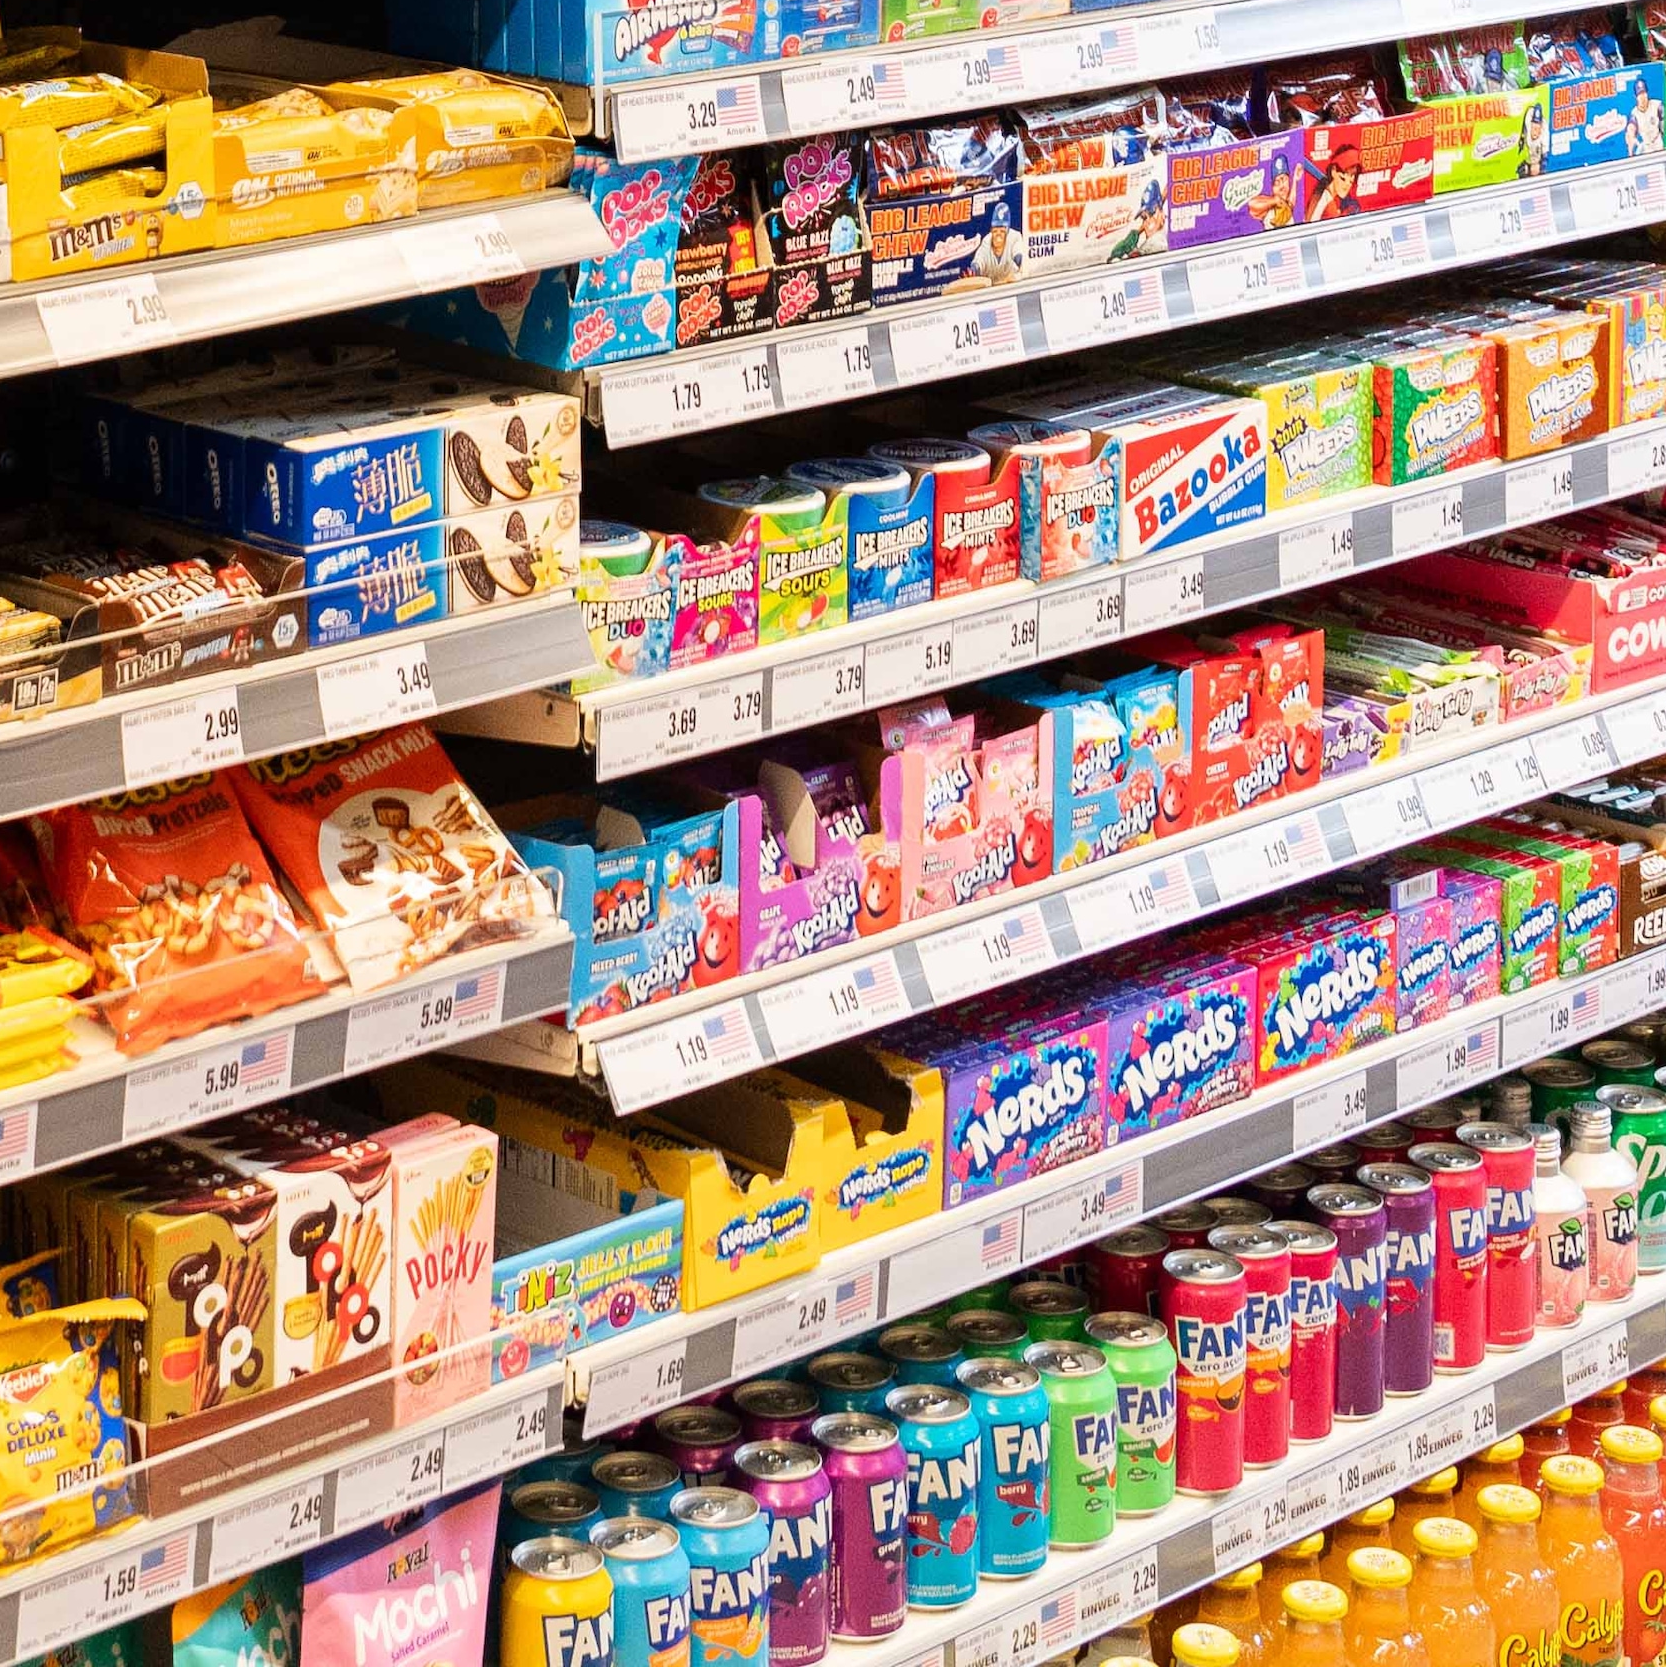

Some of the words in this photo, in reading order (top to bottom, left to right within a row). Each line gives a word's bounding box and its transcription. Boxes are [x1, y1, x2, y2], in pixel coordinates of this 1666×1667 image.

[1172, 155, 1201, 180] BIG
[1205, 149, 1258, 174] LEAGUE
[1027, 181, 1056, 203] BIG
[1061, 174, 1127, 201] LEAGUE
[1172, 176, 1220, 199] CHEW
[871, 203, 904, 228] BIG
[909, 198, 972, 224] LEAGUE
[1028, 204, 1081, 228] CHEW
[872, 231, 929, 257] CHEW
[1028, 232, 1069, 246] BUBBLE
[1028, 244, 1054, 258] GUM
[575, 309, 603, 336] POP
[573, 325, 616, 362] ROCKS
[1274, 419, 1304, 448] SOUR
[1129, 444, 1184, 490] ORIGINAL
[1135, 425, 1261, 543] Bazooka
[1209, 470, 1244, 511] BUBBLE
[1244, 458, 1266, 483] GUM
[1046, 497, 1063, 521] ICE
[1064, 479, 1114, 511] BREAKERS
[942, 510, 964, 536] ICE
[963, 500, 1014, 529] BREAKERS
[1067, 506, 1095, 527] DUO
[855, 532, 874, 556] ICE
[876, 519, 928, 549] BREAKERS
[964, 528, 996, 546] MINTS
[766, 552, 788, 583] ICE
[790, 538, 843, 568] BREAKERS
[877, 549, 911, 567] MINTS
[339, 751, 397, 785] SNACK
[395, 725, 434, 756] MIX
[577, 1242, 628, 1278] JELLY
[630, 1226, 672, 1264] ROPE
[7, 1411, 60, 1437] CHIPS
[7, 1425, 67, 1455] DELUXE
[24, 1447, 58, 1466] Minis
[998, 1484, 1027, 1498] berry
